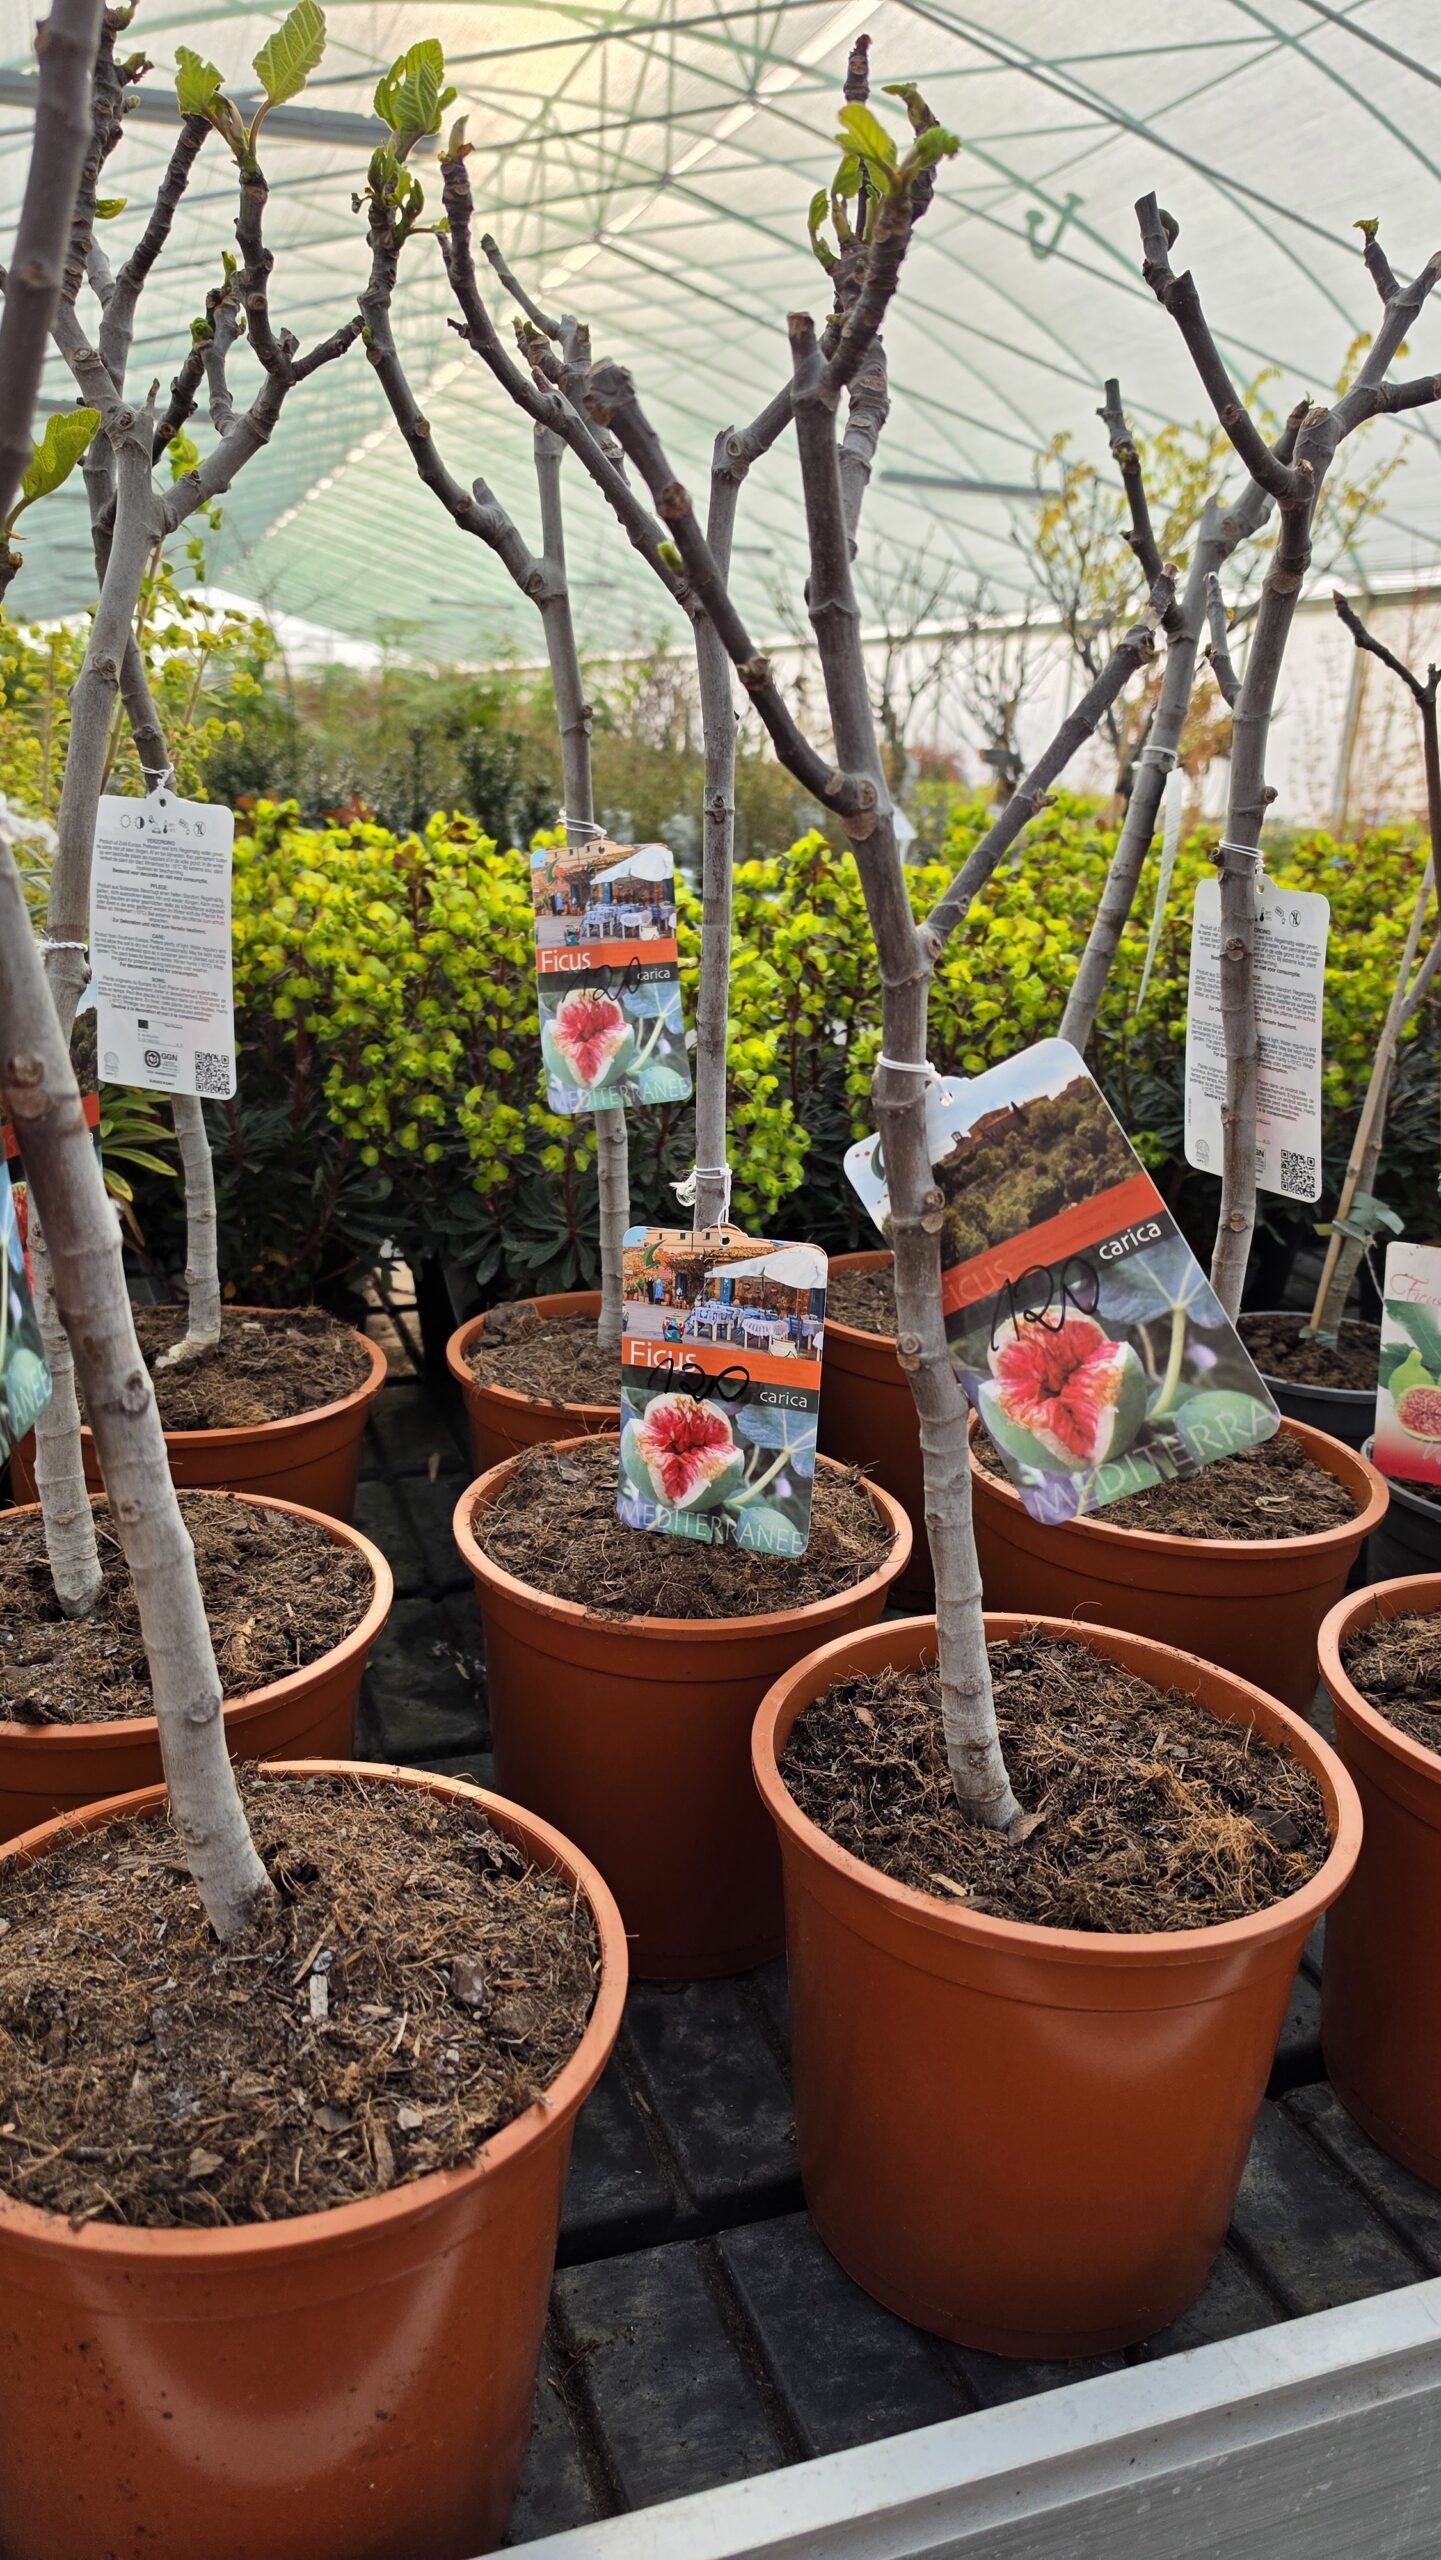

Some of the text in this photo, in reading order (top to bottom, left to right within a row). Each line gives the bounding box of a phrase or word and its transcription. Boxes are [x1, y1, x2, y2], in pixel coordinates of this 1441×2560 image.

[541, 950, 591, 972] Ficus
[637, 968, 670, 981] carica
[1099, 1222, 1162, 1260] carica
[943, 1258, 1012, 1308] icus
[629, 1340, 697, 1373] Ficus
[648, 1358, 750, 1403] 120
[759, 1391, 808, 1408] carica
[618, 1500, 804, 1555] MEDITERRANEE
